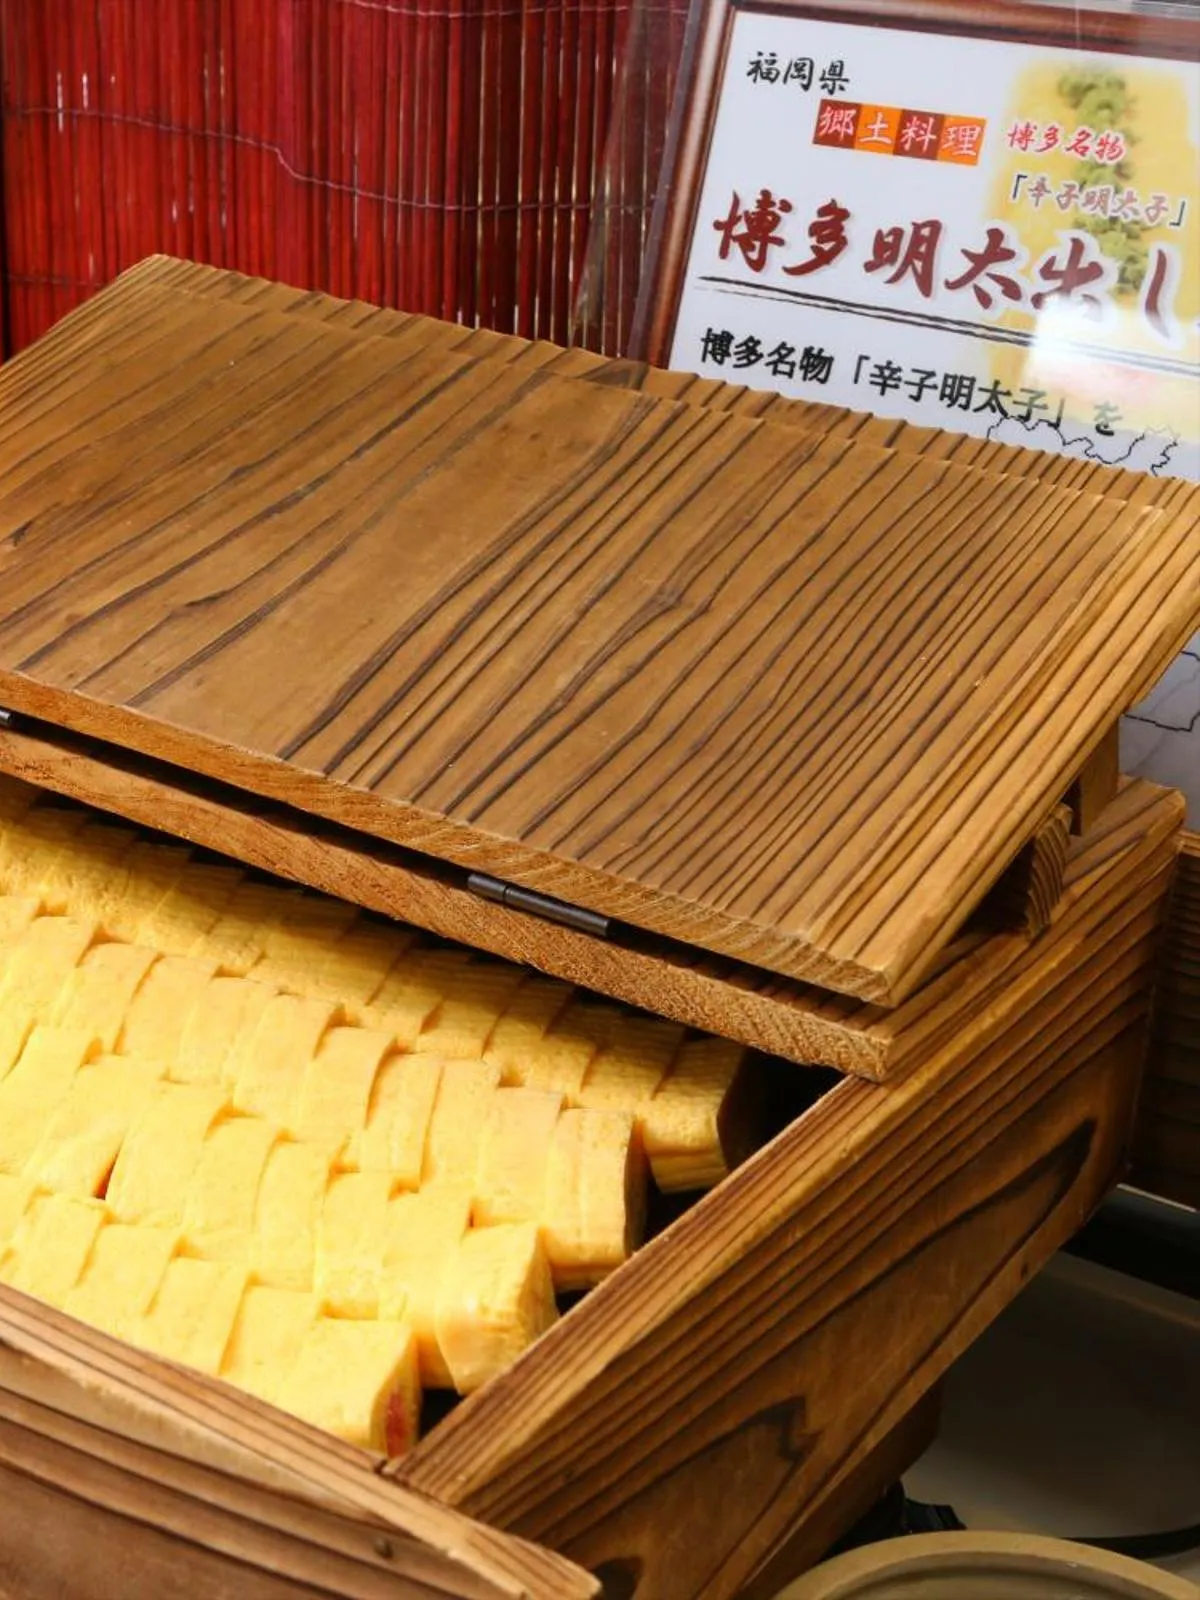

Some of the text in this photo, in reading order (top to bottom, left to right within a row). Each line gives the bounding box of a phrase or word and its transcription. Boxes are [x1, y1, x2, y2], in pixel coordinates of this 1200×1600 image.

[745, 50, 851, 96] 福岡県
[817, 104, 983, 158] 郷土料理
[1006, 121, 1126, 161] 博多名物
[1011, 172, 1187, 228] 「辛子明太子」
